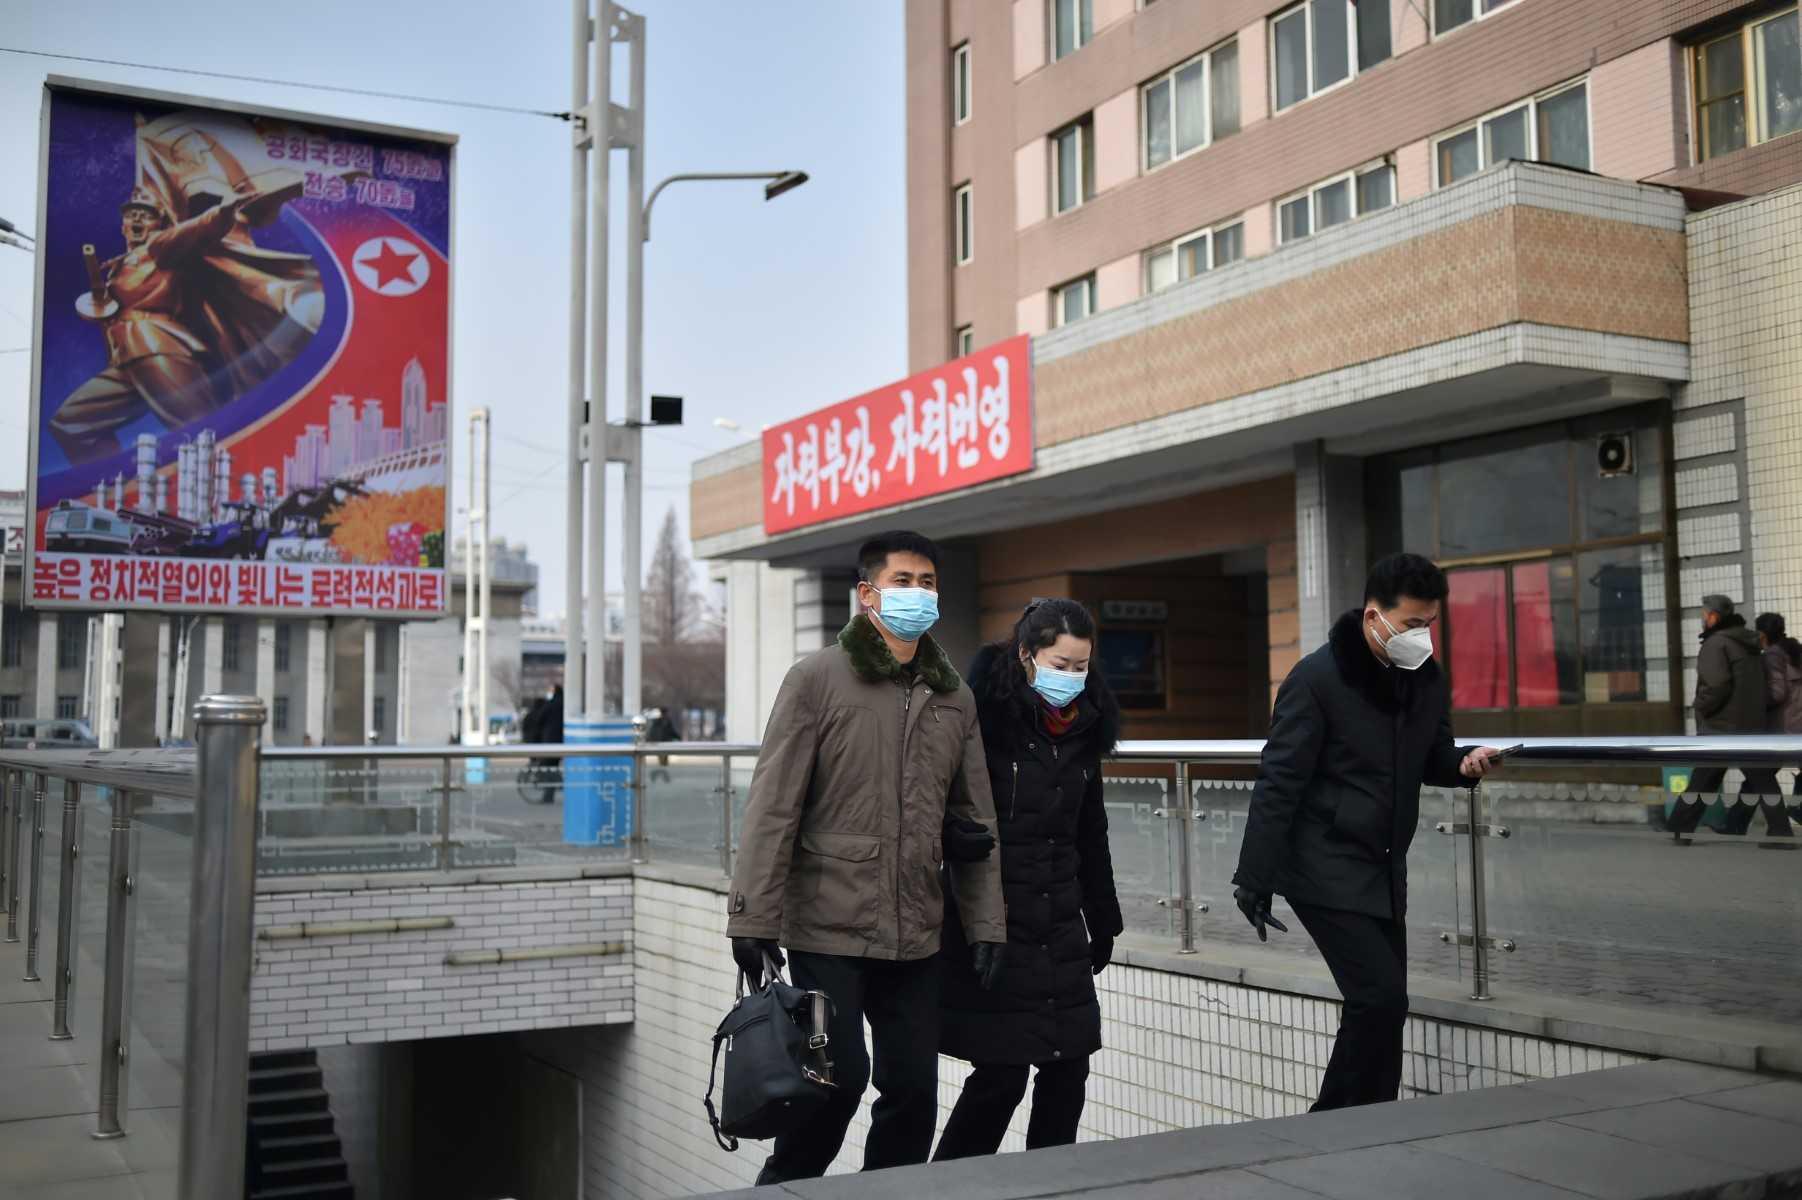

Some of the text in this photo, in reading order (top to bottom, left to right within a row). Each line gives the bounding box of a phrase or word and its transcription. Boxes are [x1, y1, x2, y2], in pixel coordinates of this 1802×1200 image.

[265, 135, 374, 171] 공화국창건
[303, 171, 346, 201] 전승
[771, 355, 1010, 516] 자력부강, 자력번영
[33, 556, 445, 611] 높은 정치적열의와 빛나는 로력적성과로!
